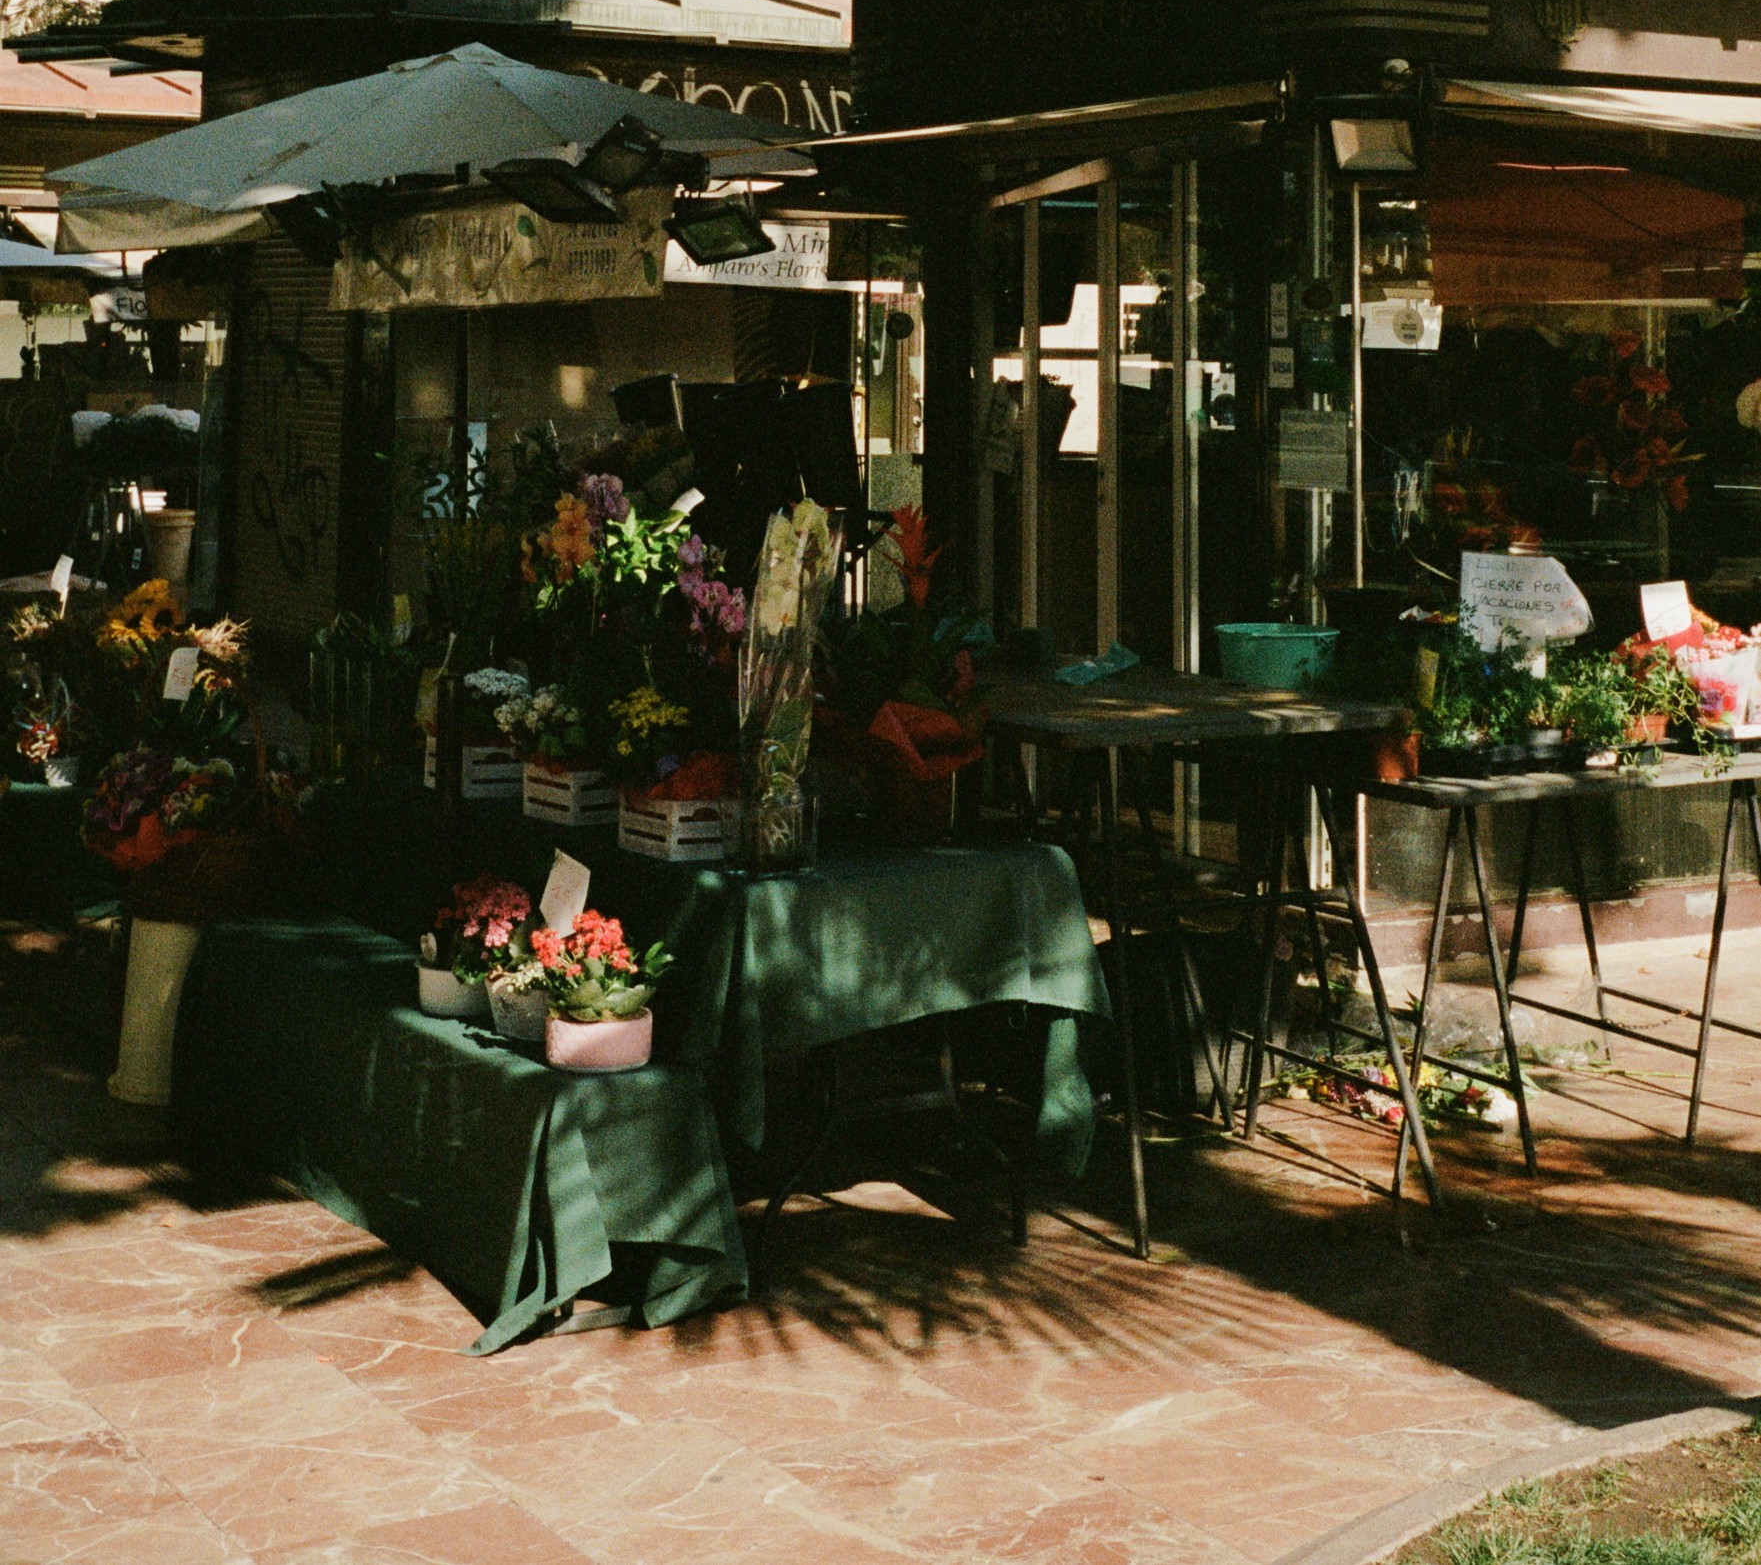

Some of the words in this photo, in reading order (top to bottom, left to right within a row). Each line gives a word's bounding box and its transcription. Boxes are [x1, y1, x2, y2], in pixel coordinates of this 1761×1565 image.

[1471, 576, 1525, 593] CIERRE
[1533, 580, 1563, 594] POR
[1473, 593, 1556, 613] VACACIONES
